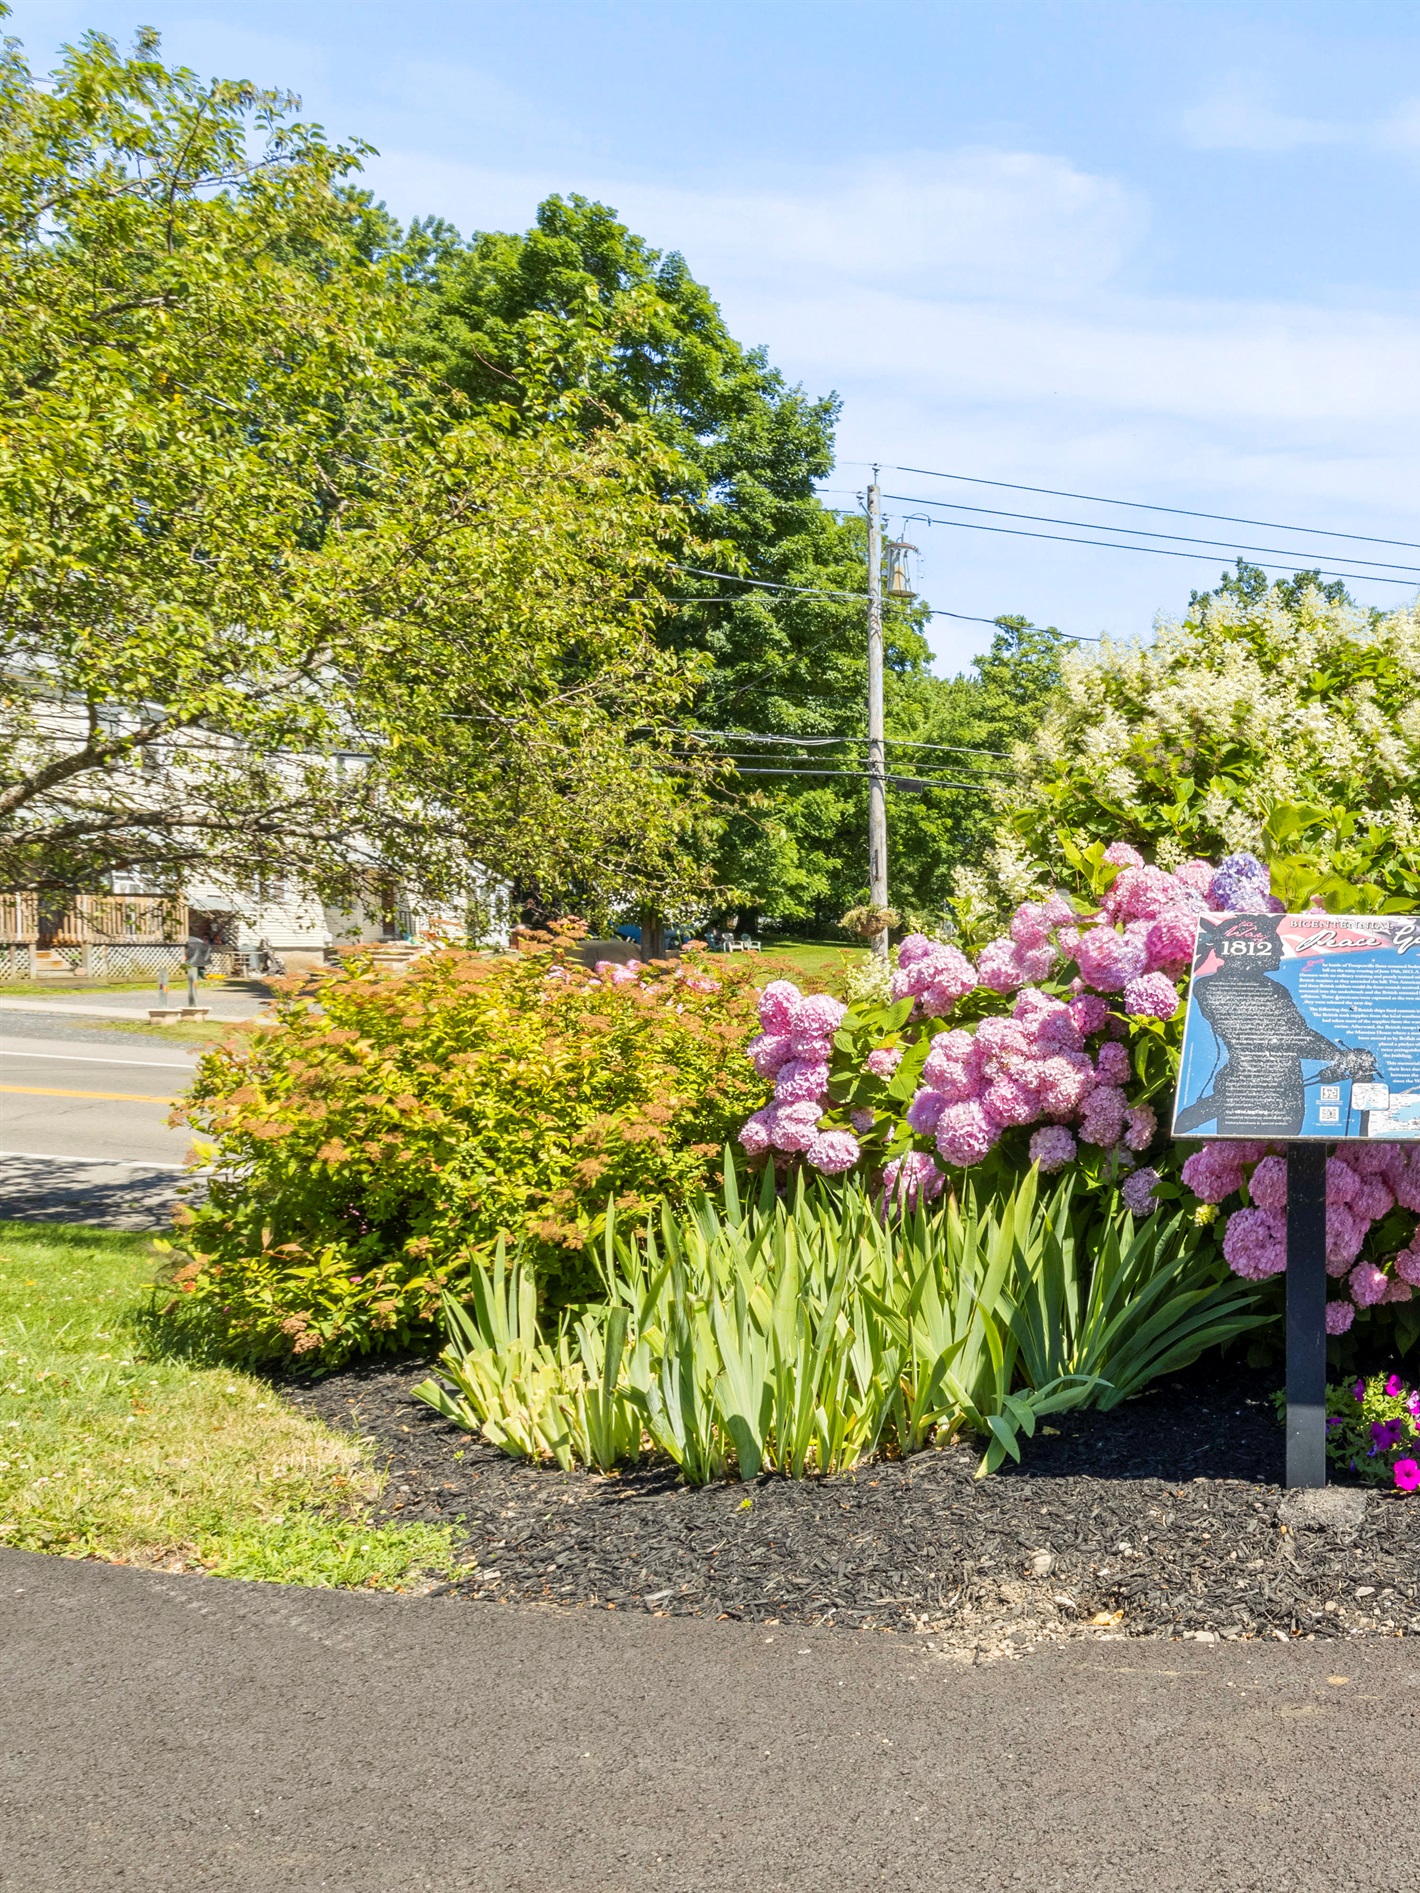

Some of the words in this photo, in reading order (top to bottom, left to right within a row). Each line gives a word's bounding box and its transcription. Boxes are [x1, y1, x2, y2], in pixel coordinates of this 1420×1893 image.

[1290, 920, 1394, 930] BICENTENNIAL
[1221, 941, 1272, 956] 1812
[1296, 930, 1381, 952] Peace
